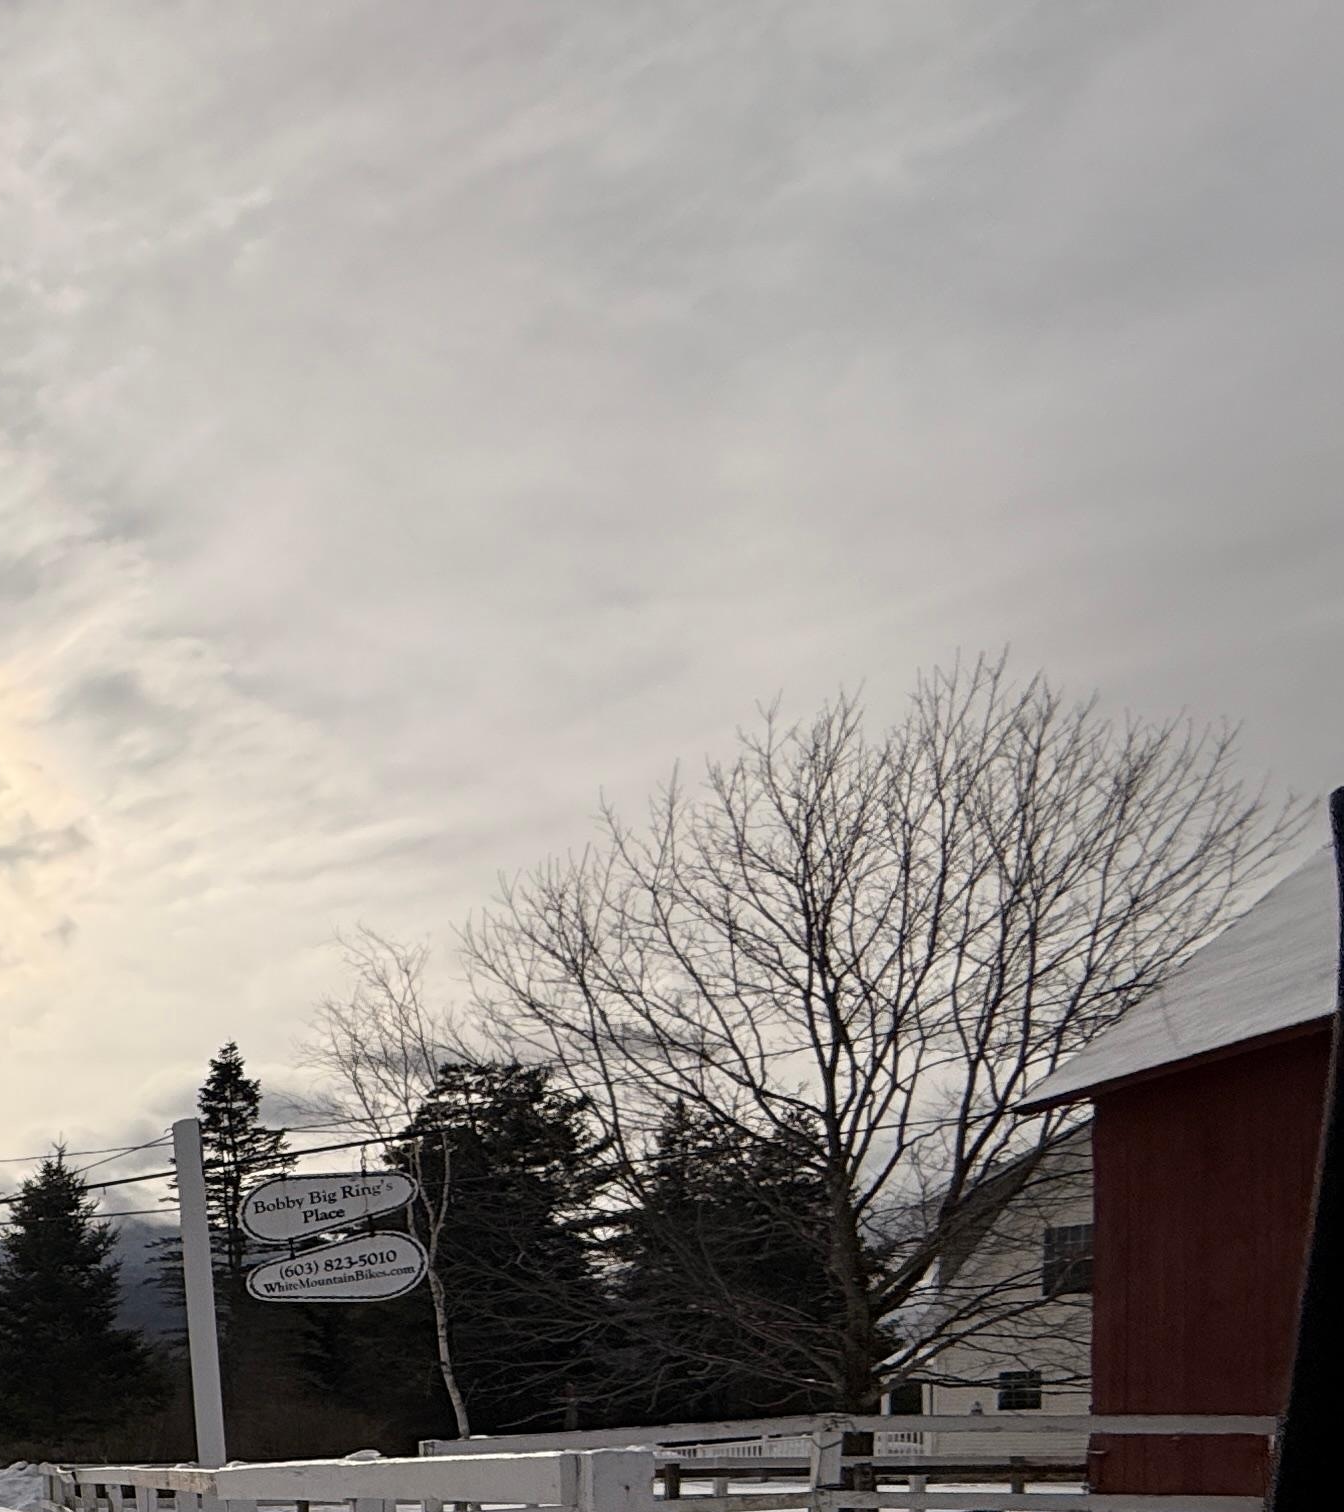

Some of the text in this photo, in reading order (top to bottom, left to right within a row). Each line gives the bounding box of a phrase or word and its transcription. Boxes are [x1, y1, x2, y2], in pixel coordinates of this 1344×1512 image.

[253, 1179, 393, 1214] Bobby Big Ring's
[302, 1208, 345, 1224] Place
[263, 1265, 416, 1294] WhiteMountainBikes.com
[279, 1250, 398, 1281] (603) 823-5010
